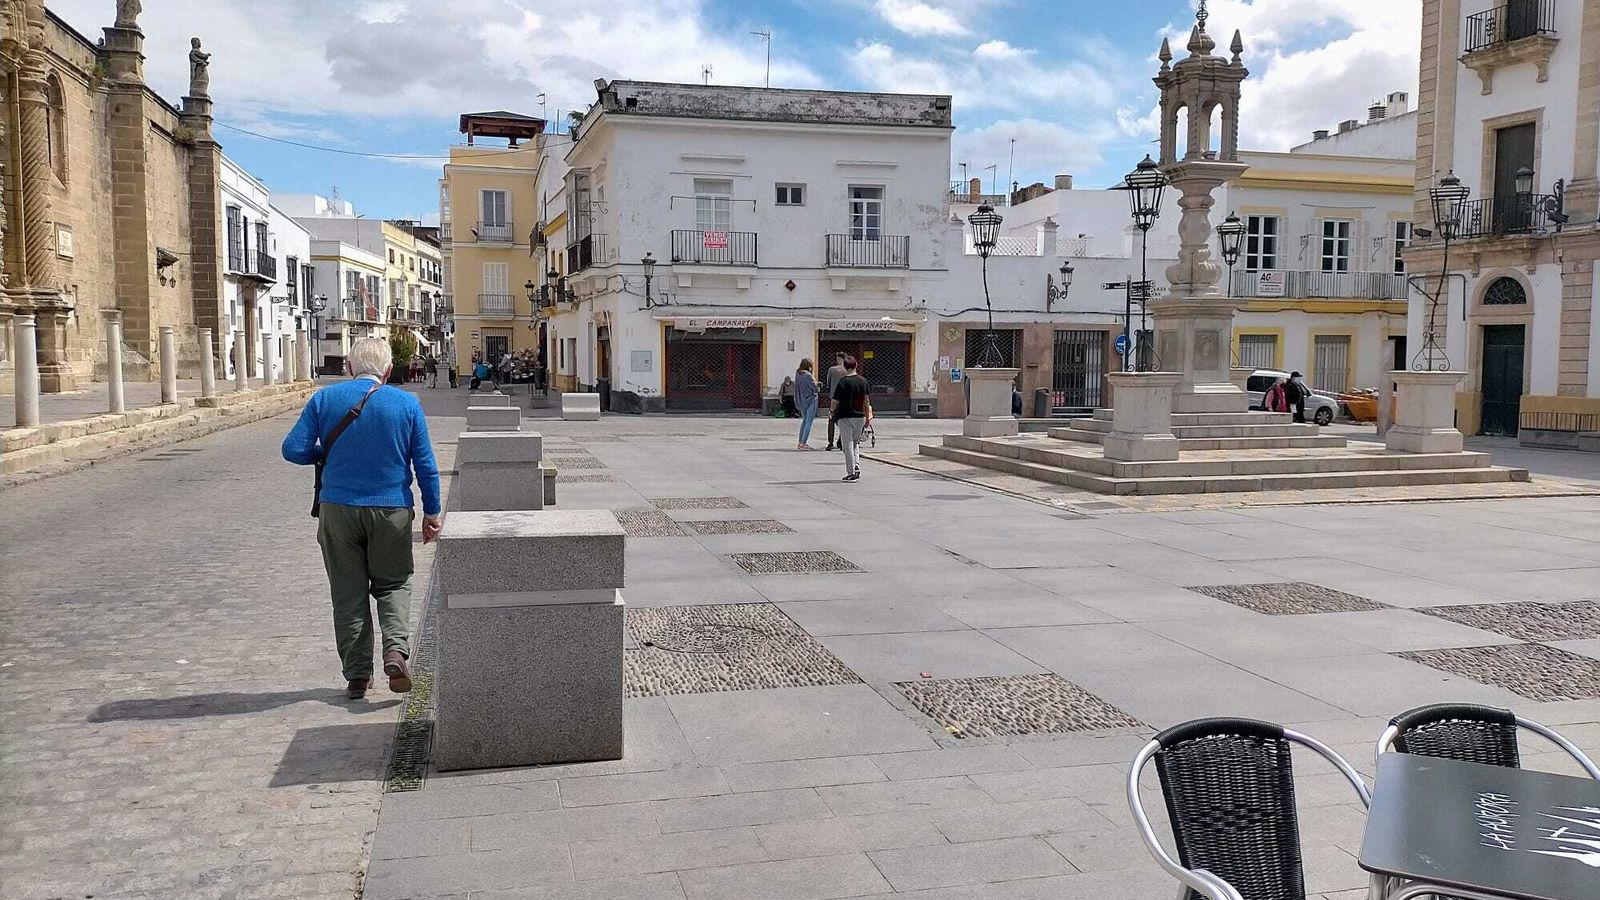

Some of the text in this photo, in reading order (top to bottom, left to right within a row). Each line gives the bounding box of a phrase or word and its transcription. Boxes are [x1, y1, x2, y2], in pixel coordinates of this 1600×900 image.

[1260, 273, 1272, 281] AG
[706, 319, 755, 327] CAMPANARIO
[1473, 792, 1521, 851] LA AURORA
